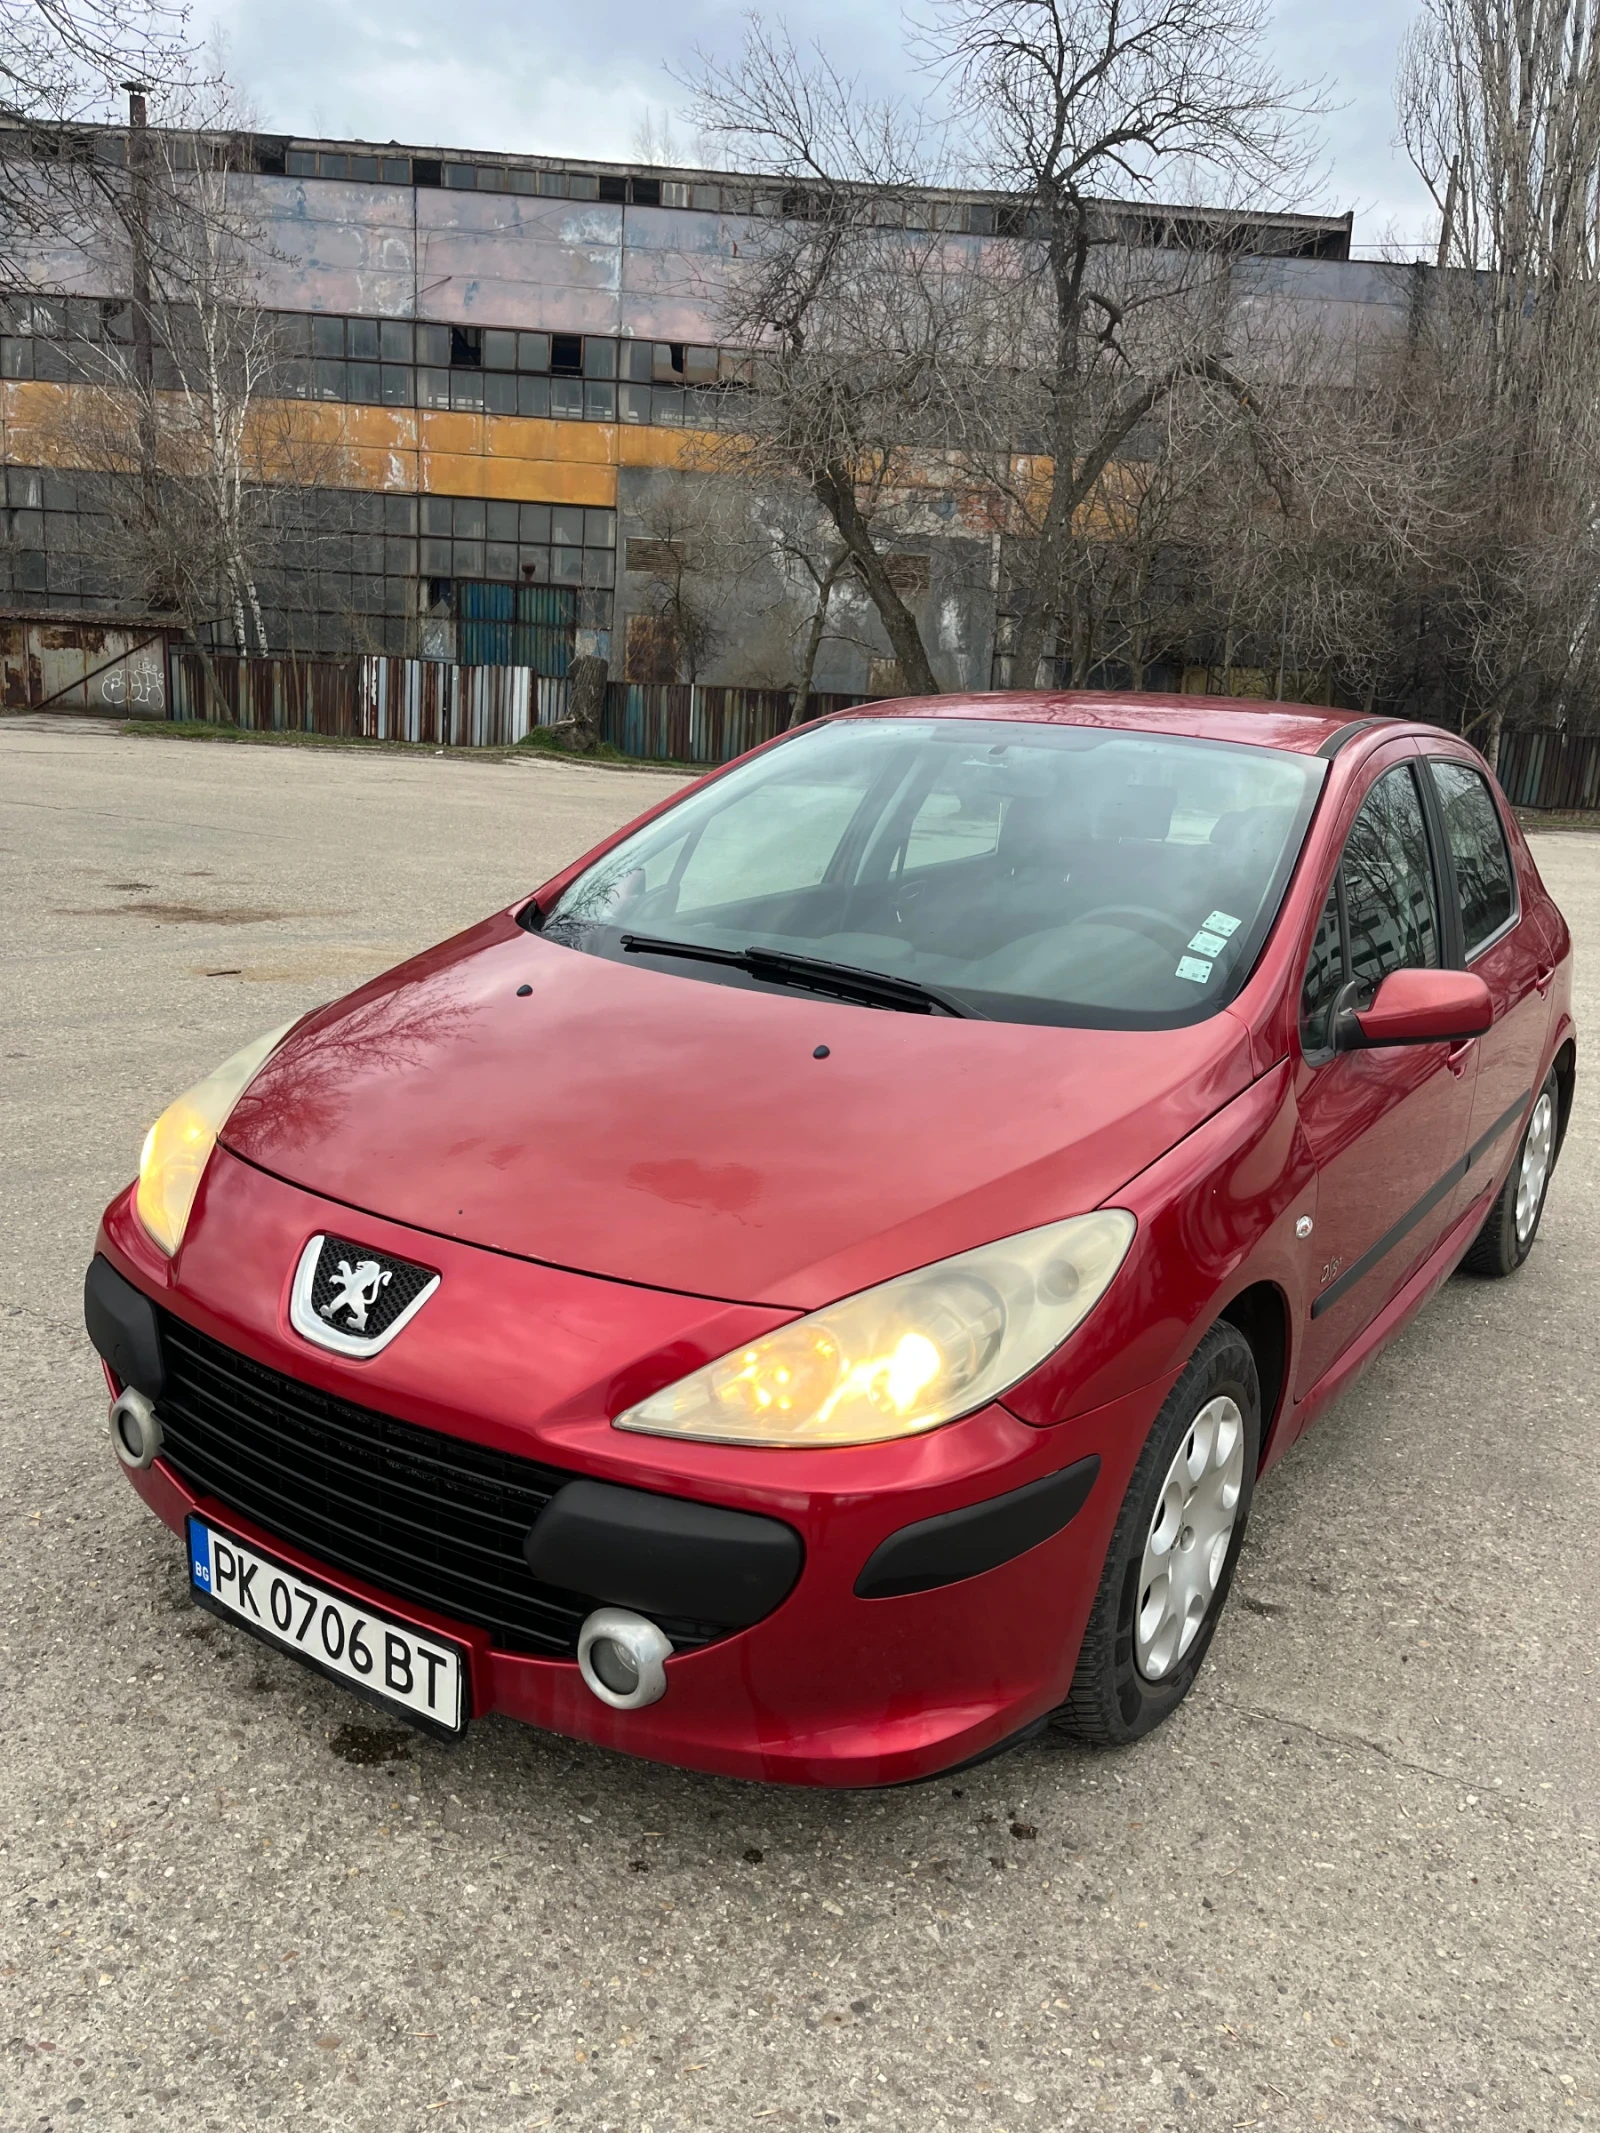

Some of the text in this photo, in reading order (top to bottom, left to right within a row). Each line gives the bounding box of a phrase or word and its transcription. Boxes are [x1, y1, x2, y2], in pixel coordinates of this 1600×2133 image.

[195, 1560, 210, 1582] BG
[213, 1540, 448, 1710] PK 0706 BT
